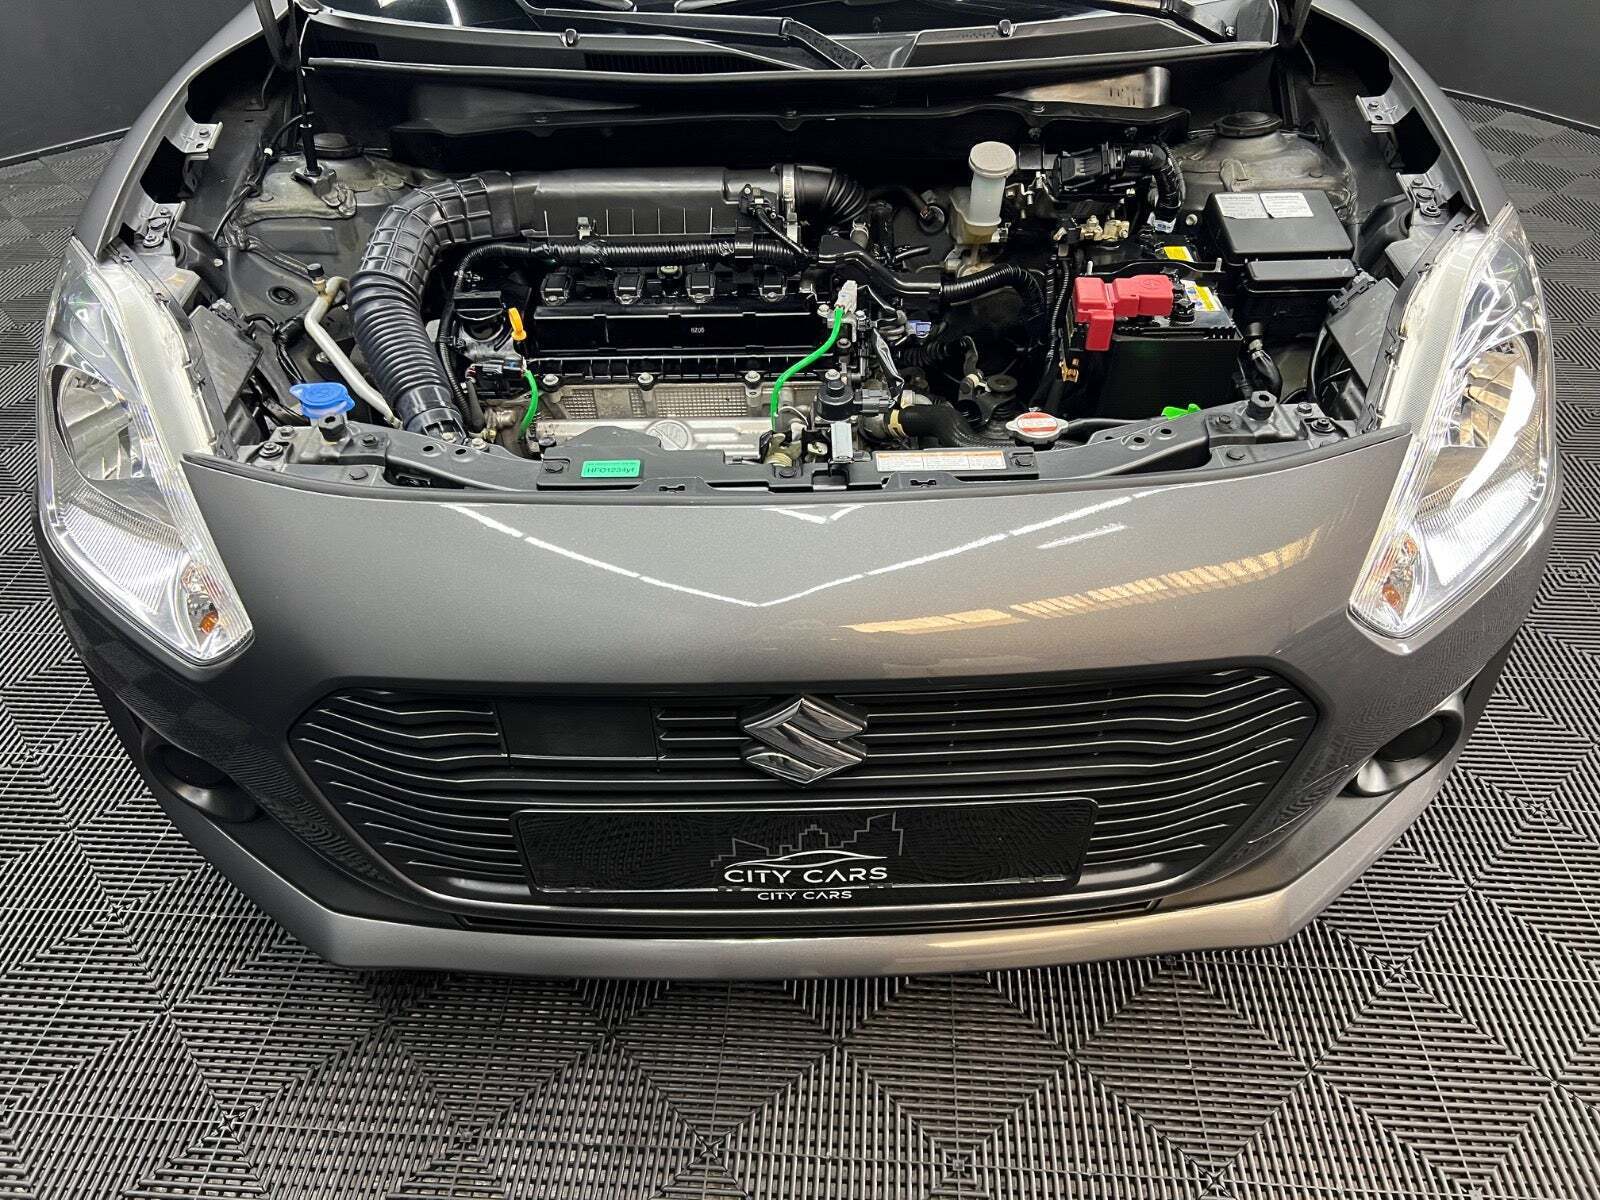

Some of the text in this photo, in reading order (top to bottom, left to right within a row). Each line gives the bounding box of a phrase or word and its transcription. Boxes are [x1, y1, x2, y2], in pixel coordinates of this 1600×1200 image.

[724, 867, 888, 883] CITY CARS
[757, 891, 853, 900] CITY CARS
